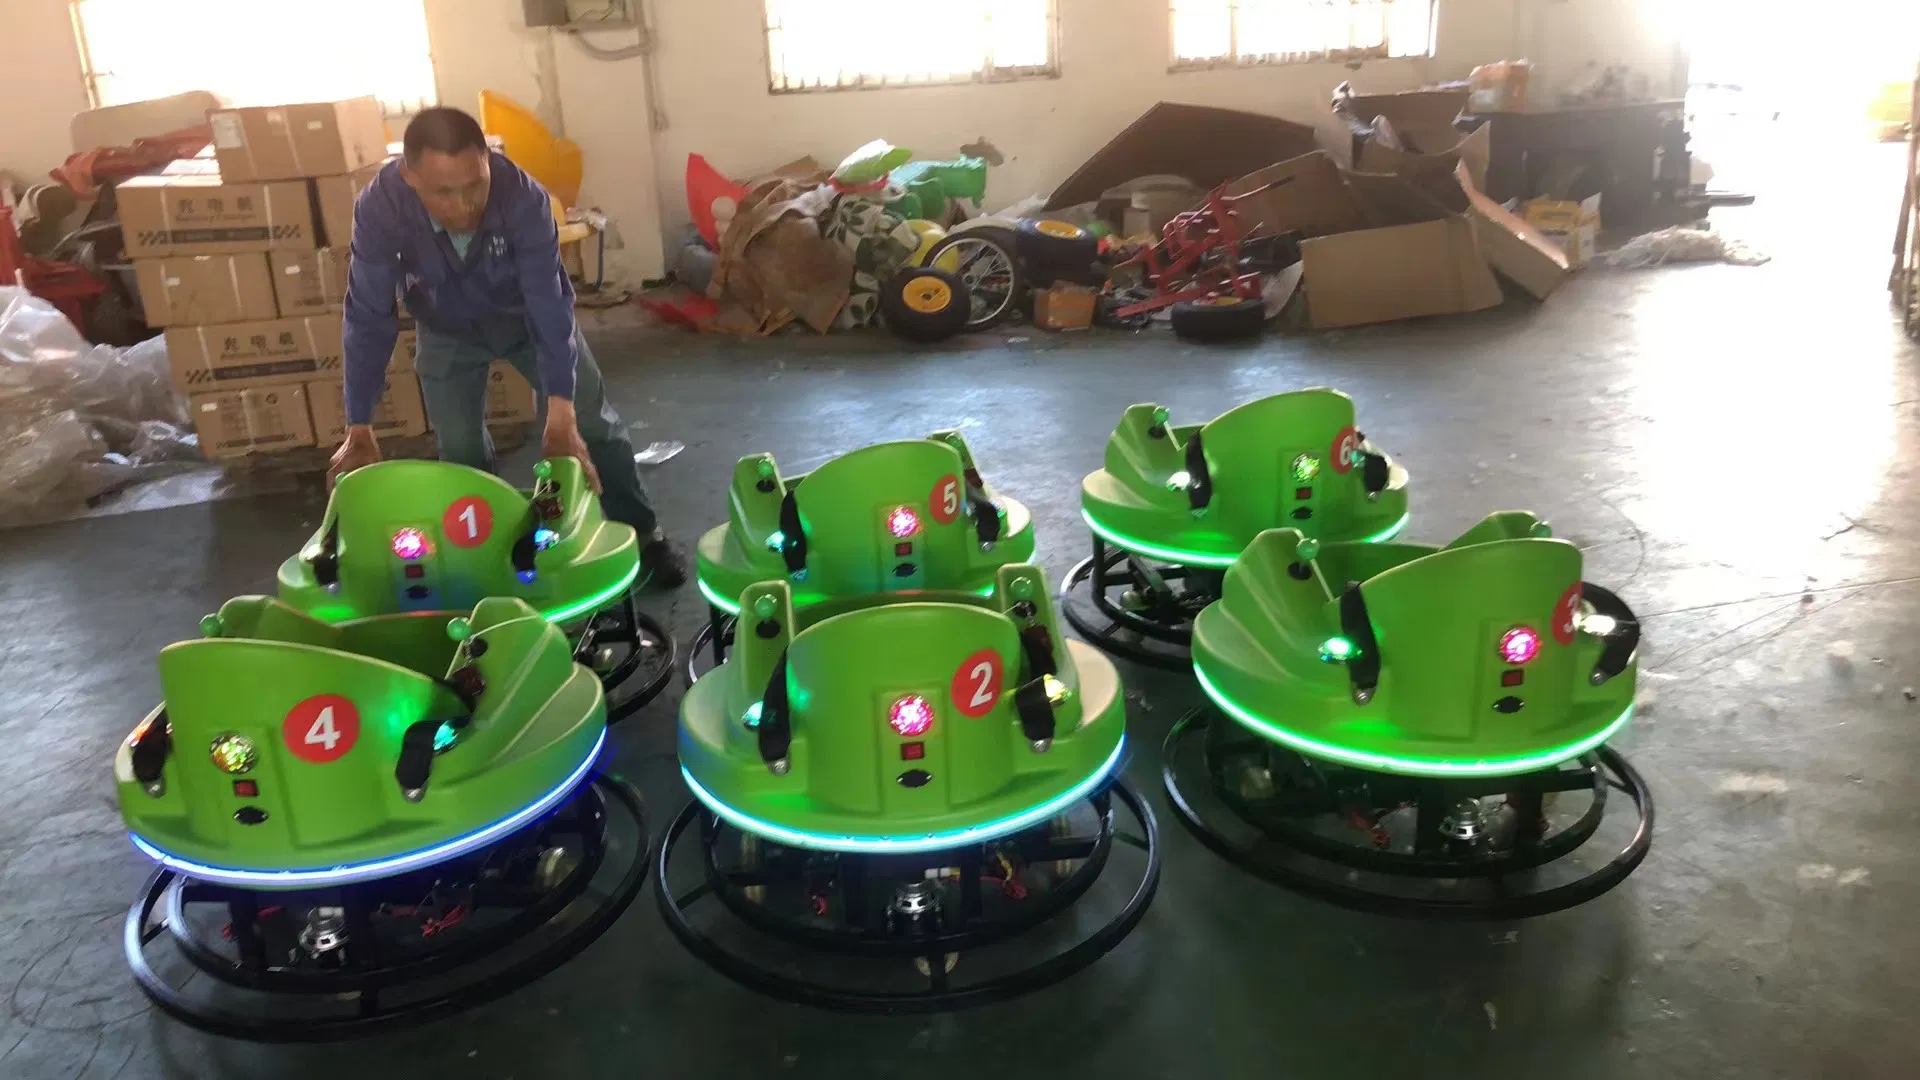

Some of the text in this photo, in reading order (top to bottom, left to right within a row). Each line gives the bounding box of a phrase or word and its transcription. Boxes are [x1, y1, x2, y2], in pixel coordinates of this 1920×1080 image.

[1339, 434, 1353, 467] 6
[943, 480, 958, 515] 5
[458, 503, 478, 539] 1
[969, 661, 993, 708] 2
[304, 705, 341, 750] 4
